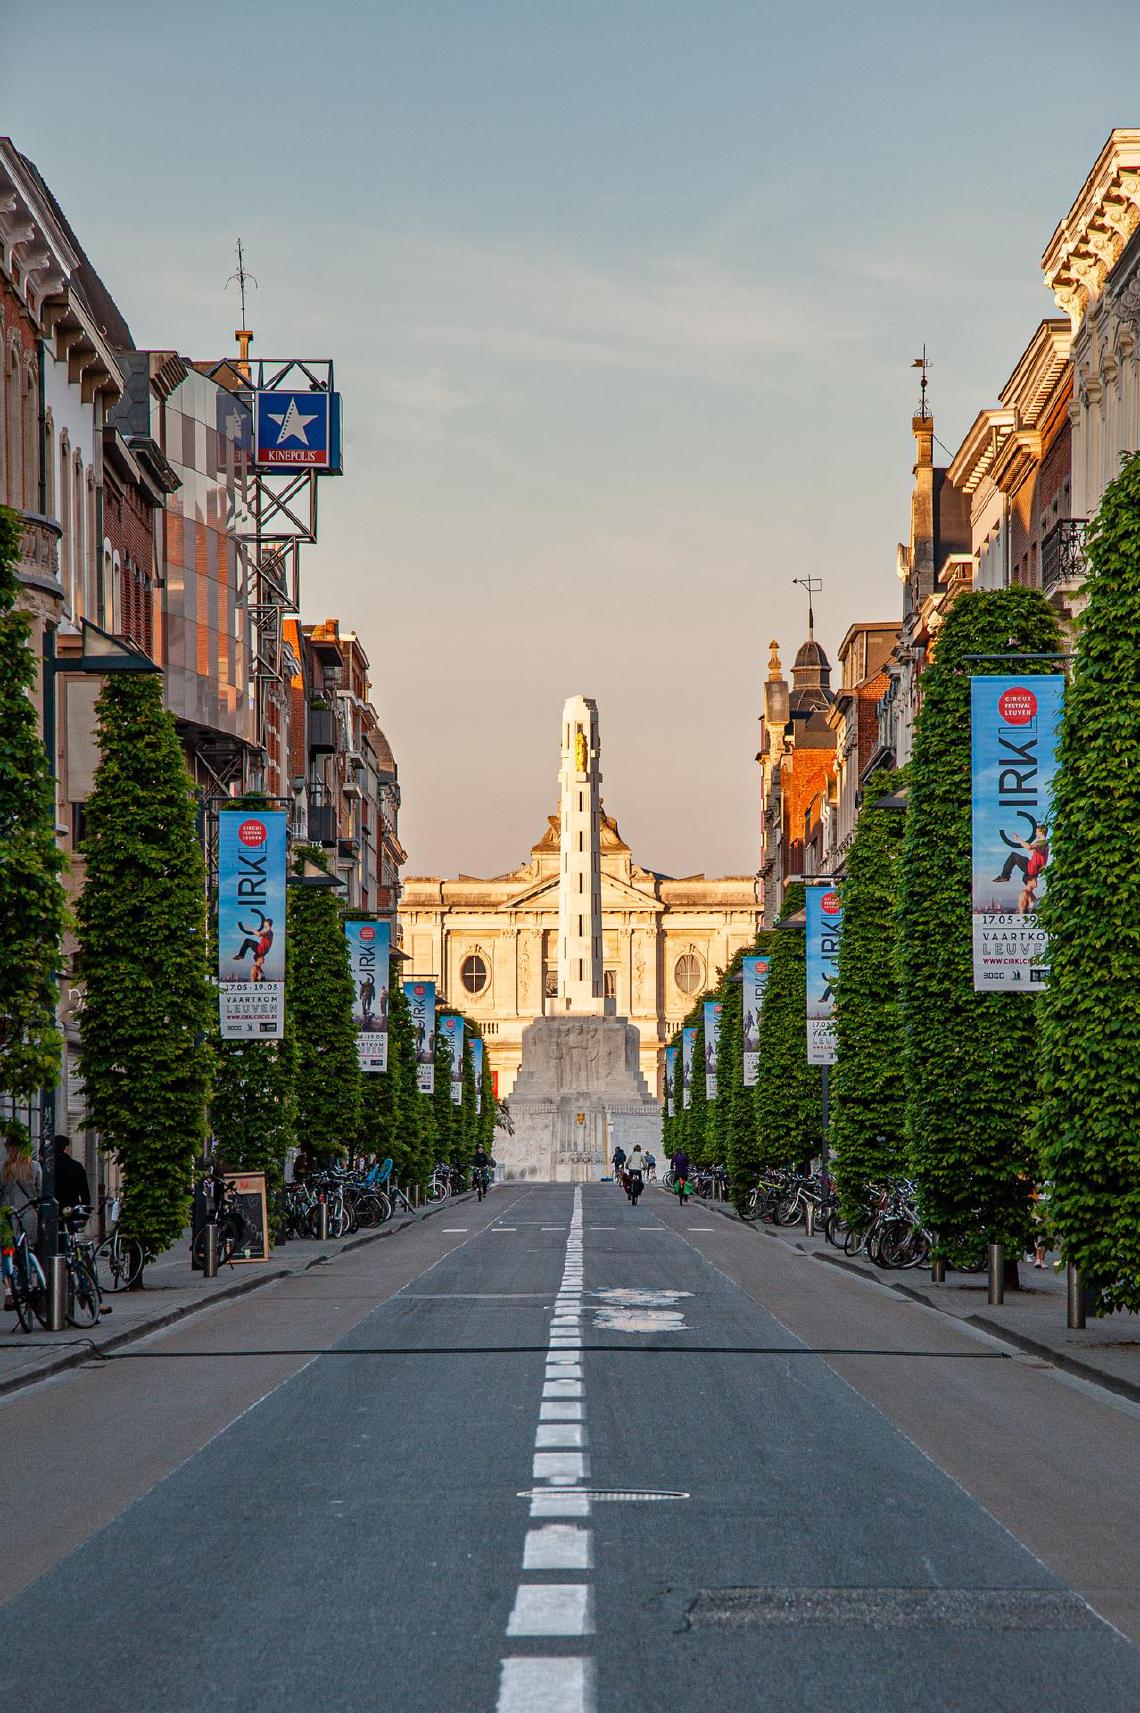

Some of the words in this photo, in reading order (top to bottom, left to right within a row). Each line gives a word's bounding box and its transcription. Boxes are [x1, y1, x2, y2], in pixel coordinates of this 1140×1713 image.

[268, 450, 316, 461] KINEPOLIS
[982, 942, 1043, 956] LEUVE
[226, 1004, 278, 1014] LEUVEN
